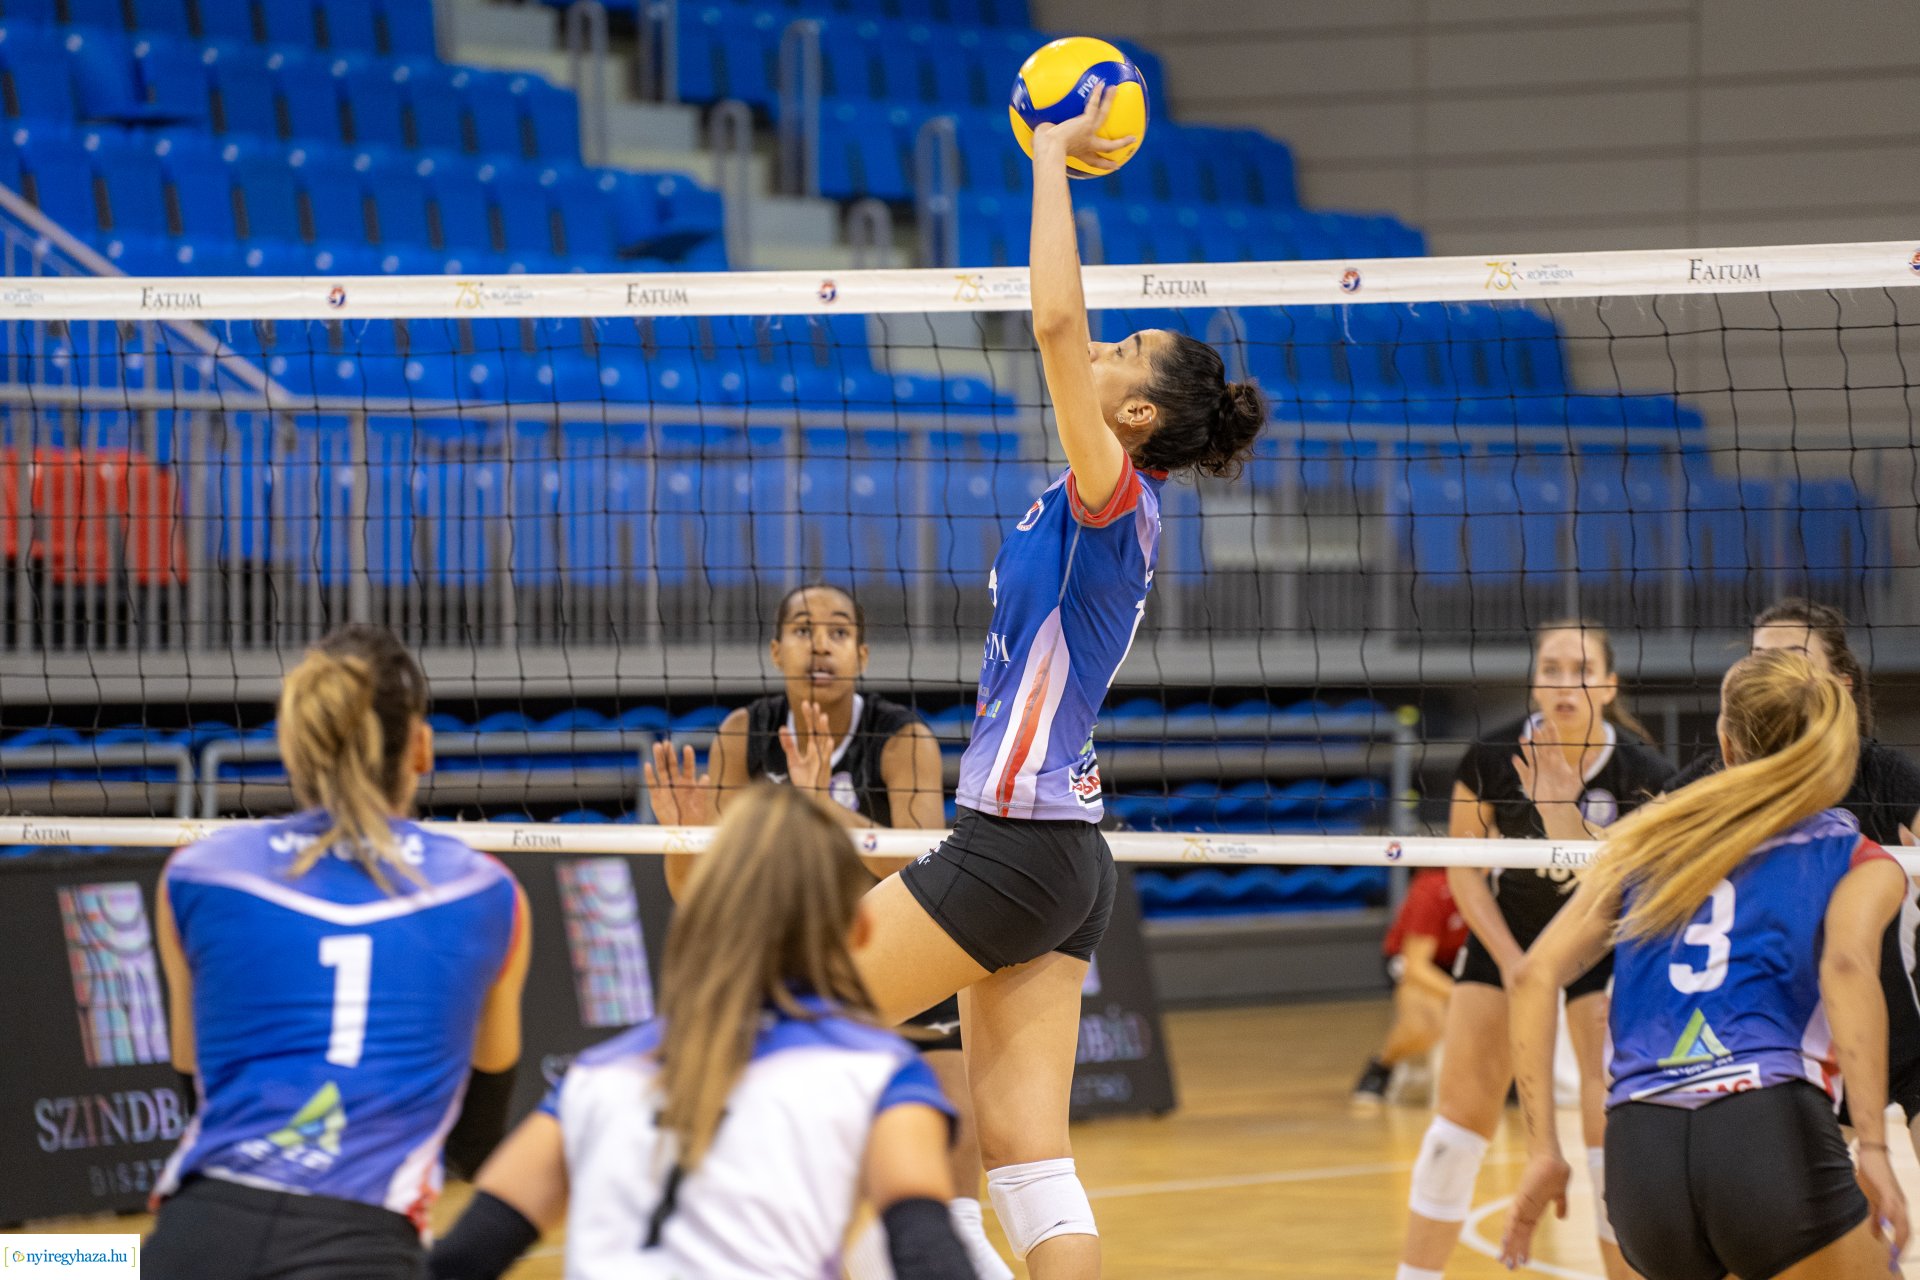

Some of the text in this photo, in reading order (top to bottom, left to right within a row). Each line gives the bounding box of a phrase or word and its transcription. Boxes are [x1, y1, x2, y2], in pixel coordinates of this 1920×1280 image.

[1078, 74, 1099, 98] FIVB
[1668, 878, 1737, 995] 3
[318, 933, 374, 1069] 1
